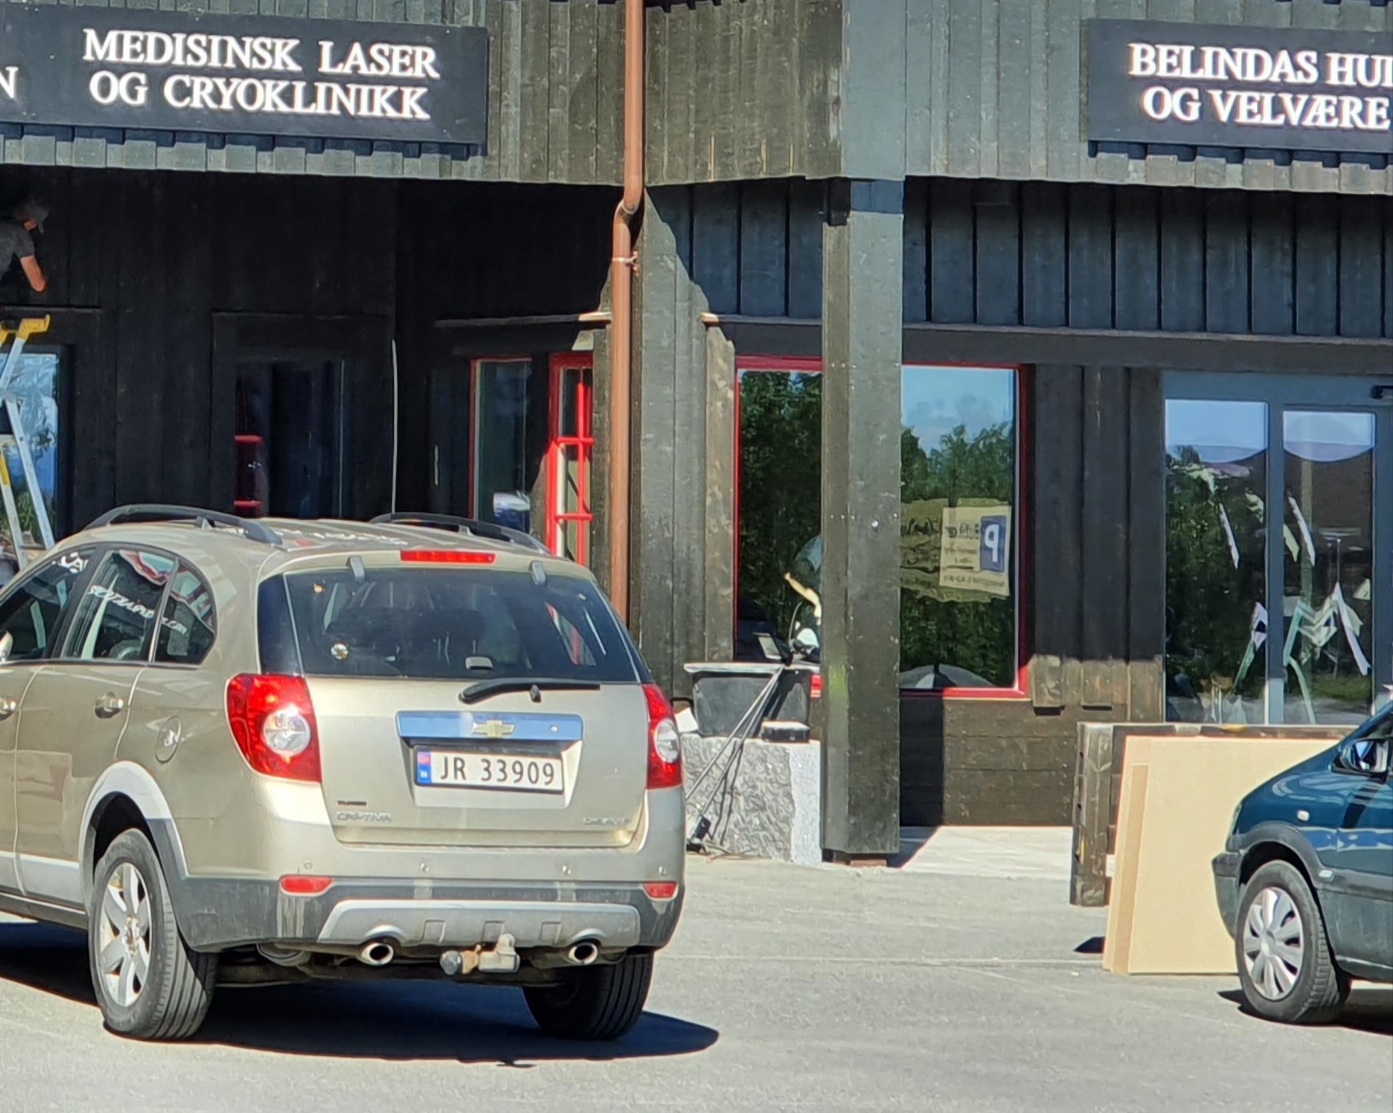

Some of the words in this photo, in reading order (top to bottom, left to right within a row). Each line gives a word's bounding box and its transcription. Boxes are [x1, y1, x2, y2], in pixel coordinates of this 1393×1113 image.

[82, 27, 303, 73] MEDISINSK
[317, 39, 441, 80] LASER
[1127, 41, 1320, 85] BELINDAS
[89, 69, 150, 107] OG
[163, 73, 431, 121] CRYOKLINIKK
[1141, 85, 1204, 123] OG
[1207, 88, 1392, 131] VELVÆRE
[440, 755, 467, 782] JR
[480, 758, 556, 786] 33909
